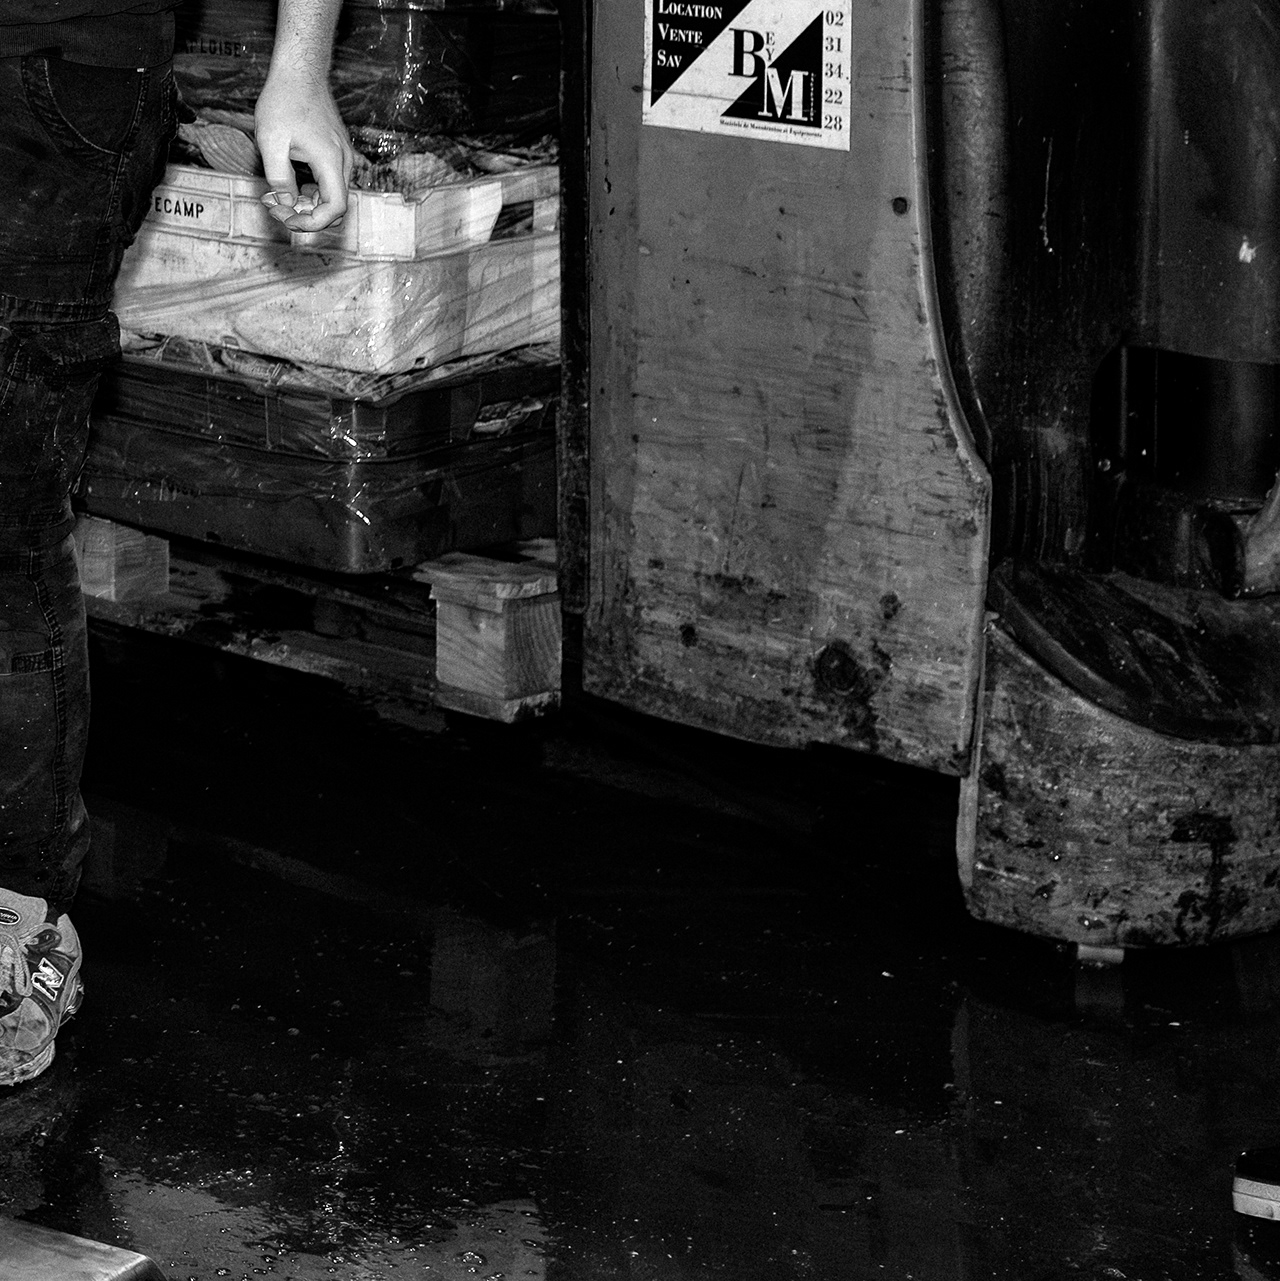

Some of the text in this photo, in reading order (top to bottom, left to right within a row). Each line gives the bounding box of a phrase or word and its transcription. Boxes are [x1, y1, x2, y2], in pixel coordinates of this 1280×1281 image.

[825, 11, 844, 26] 02
[825, 37, 842, 52] 31
[825, 63, 843, 79] 34
[824, 89, 843, 105] 22
[824, 115, 842, 131] 28
[154, 196, 204, 219] ECAMP
[31, 957, 65, 1001] N
